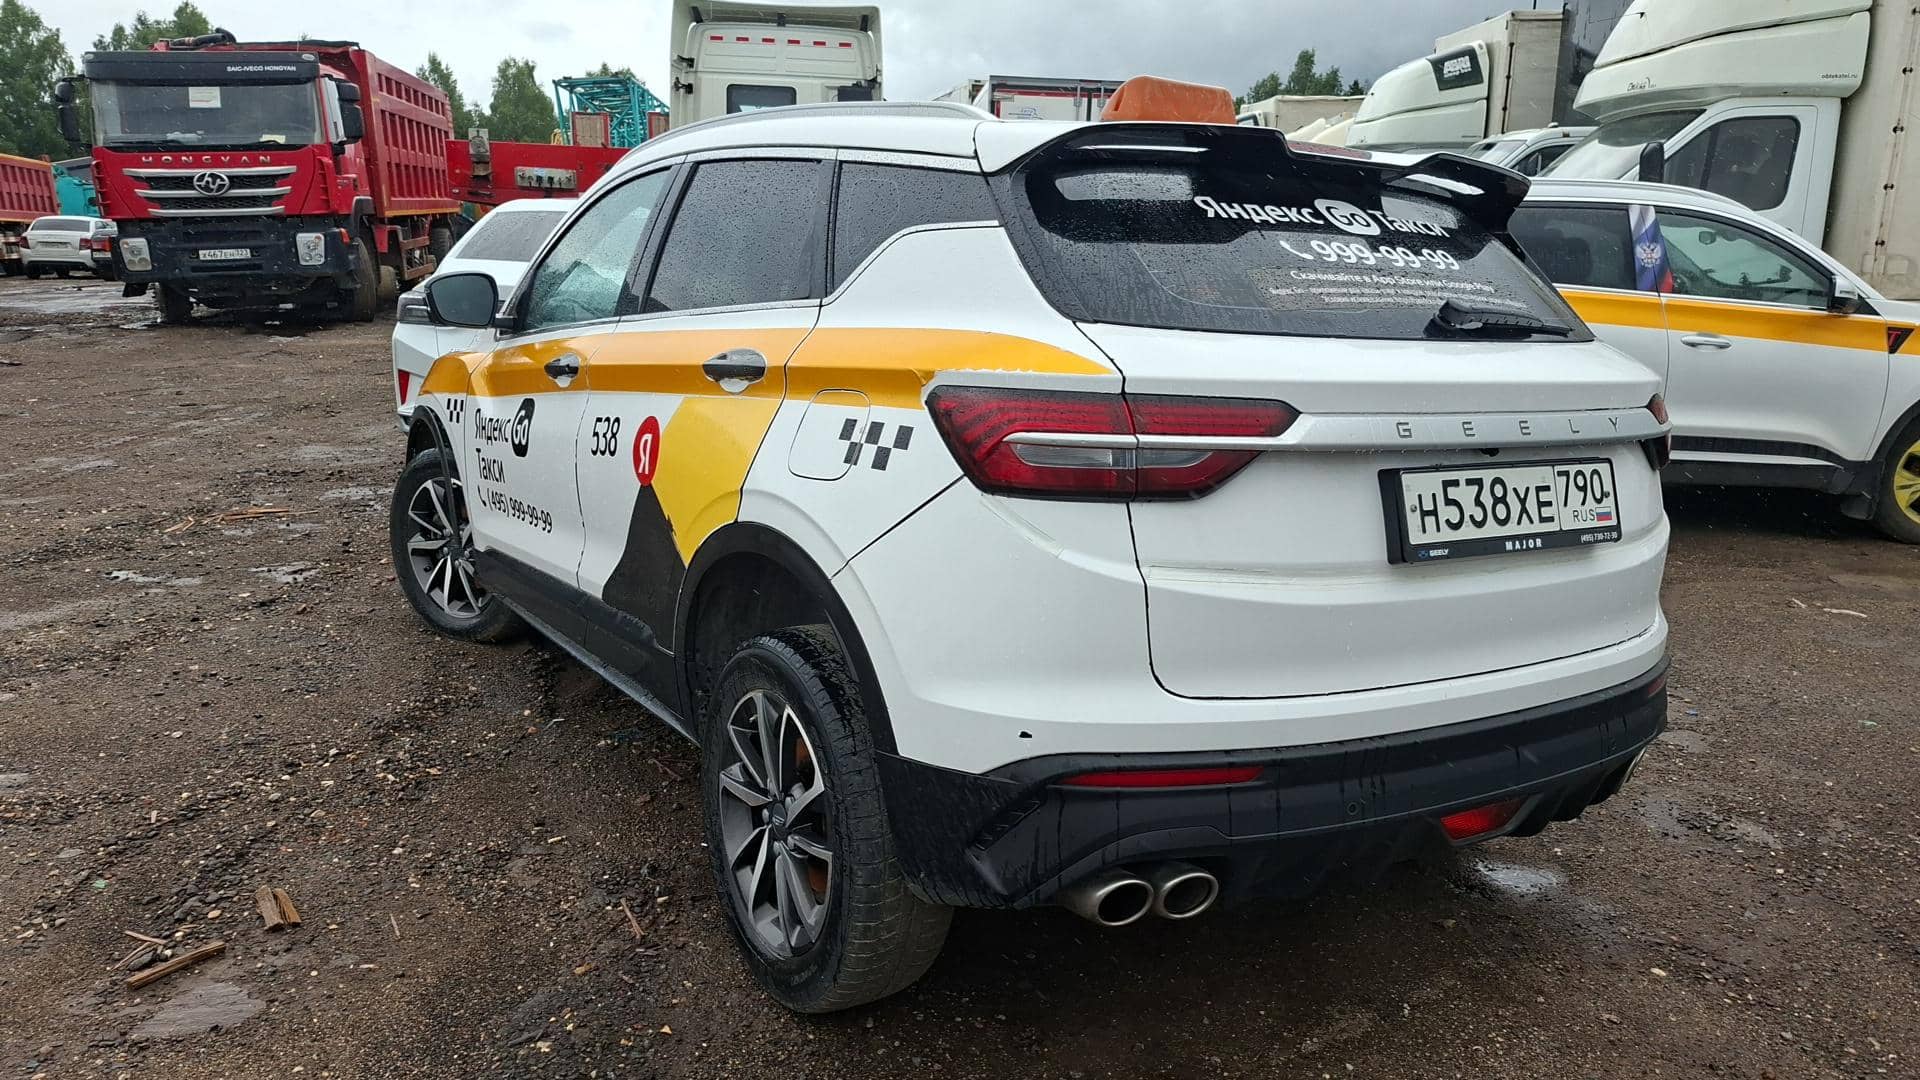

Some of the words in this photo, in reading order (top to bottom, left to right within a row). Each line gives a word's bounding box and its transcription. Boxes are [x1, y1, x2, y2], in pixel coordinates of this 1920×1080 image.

[141, 155, 272, 164] HONGYAN
[1193, 196, 1324, 225] Яндекс
[1366, 209, 1450, 238] Такси
[1310, 239, 1460, 271] 999-99-99
[474, 408, 511, 445] Яндекс
[591, 416, 620, 457] 538
[1396, 416, 1620, 439] GEELY
[475, 448, 505, 484] Такси
[638, 433, 653, 474] Я
[487, 488, 510, 518] (495)
[509, 497, 553, 534] 999-99-99
[1417, 476, 1555, 534] Н538ХЕ
[1556, 468, 1604, 507] 790
[1572, 508, 1596, 523] RUS
[1429, 548, 1449, 557] GEELY
[1505, 538, 1542, 551] MAJOR
